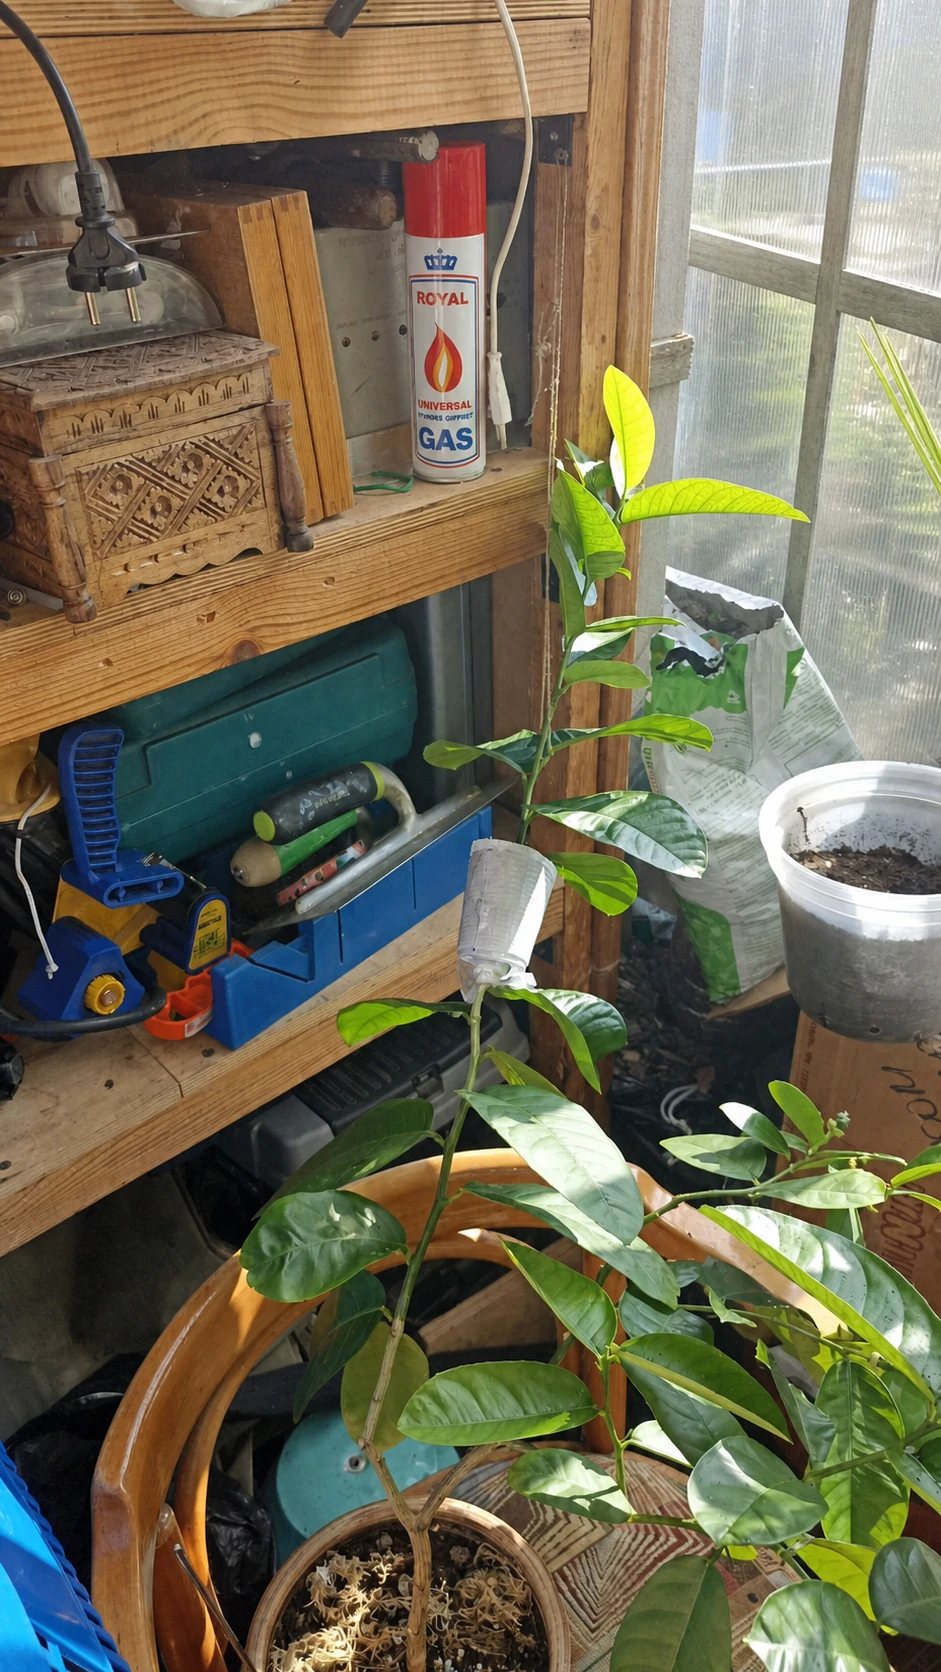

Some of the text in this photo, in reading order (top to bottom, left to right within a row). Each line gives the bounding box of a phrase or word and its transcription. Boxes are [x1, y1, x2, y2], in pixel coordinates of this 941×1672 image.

[417, 291, 469, 306] ROYAL
[418, 399, 472, 411] UNIVERSAL
[419, 426, 473, 451] GAS
